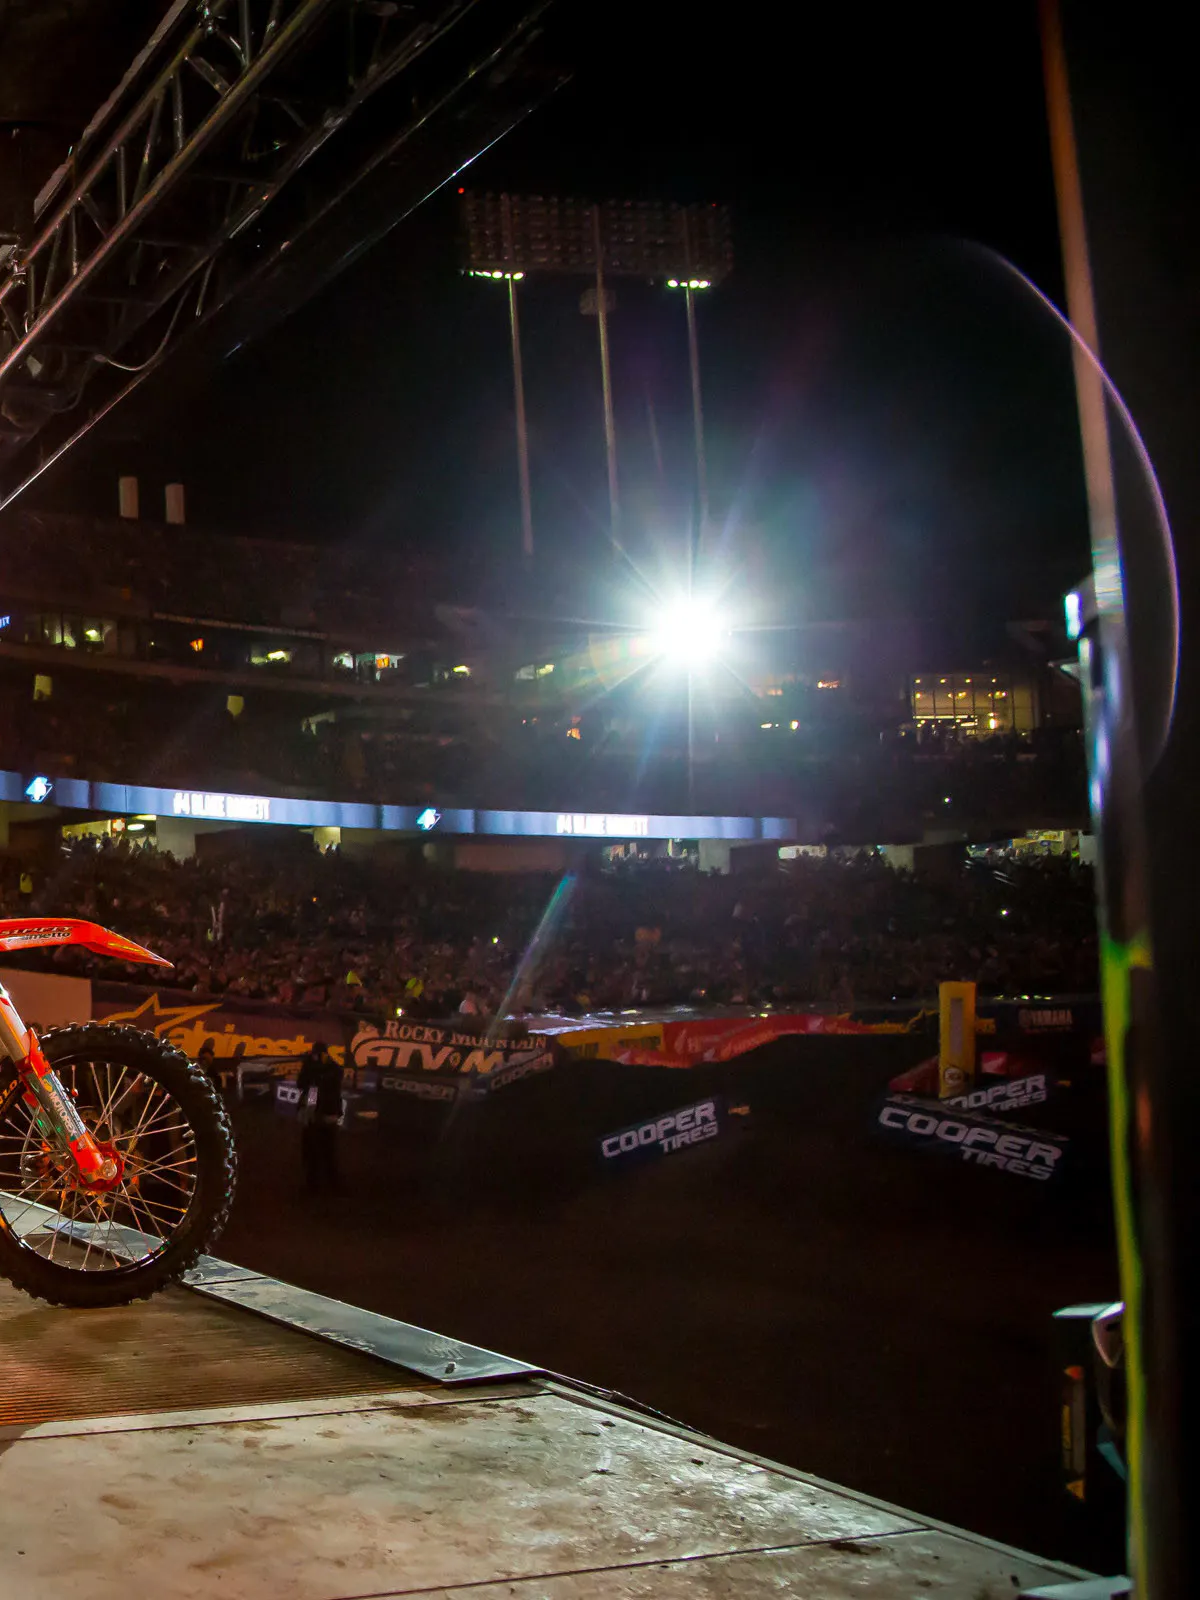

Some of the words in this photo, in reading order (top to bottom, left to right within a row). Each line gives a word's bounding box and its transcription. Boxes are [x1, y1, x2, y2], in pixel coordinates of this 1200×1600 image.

[385, 1020, 448, 1045] ROCKY
[50, 1090, 78, 1138] MOTOREX
[601, 1100, 717, 1159] COOPER
[659, 1120, 719, 1154] TIRES
[878, 1106, 1064, 1168] COOPER
[960, 1145, 1057, 1182] TIRES
